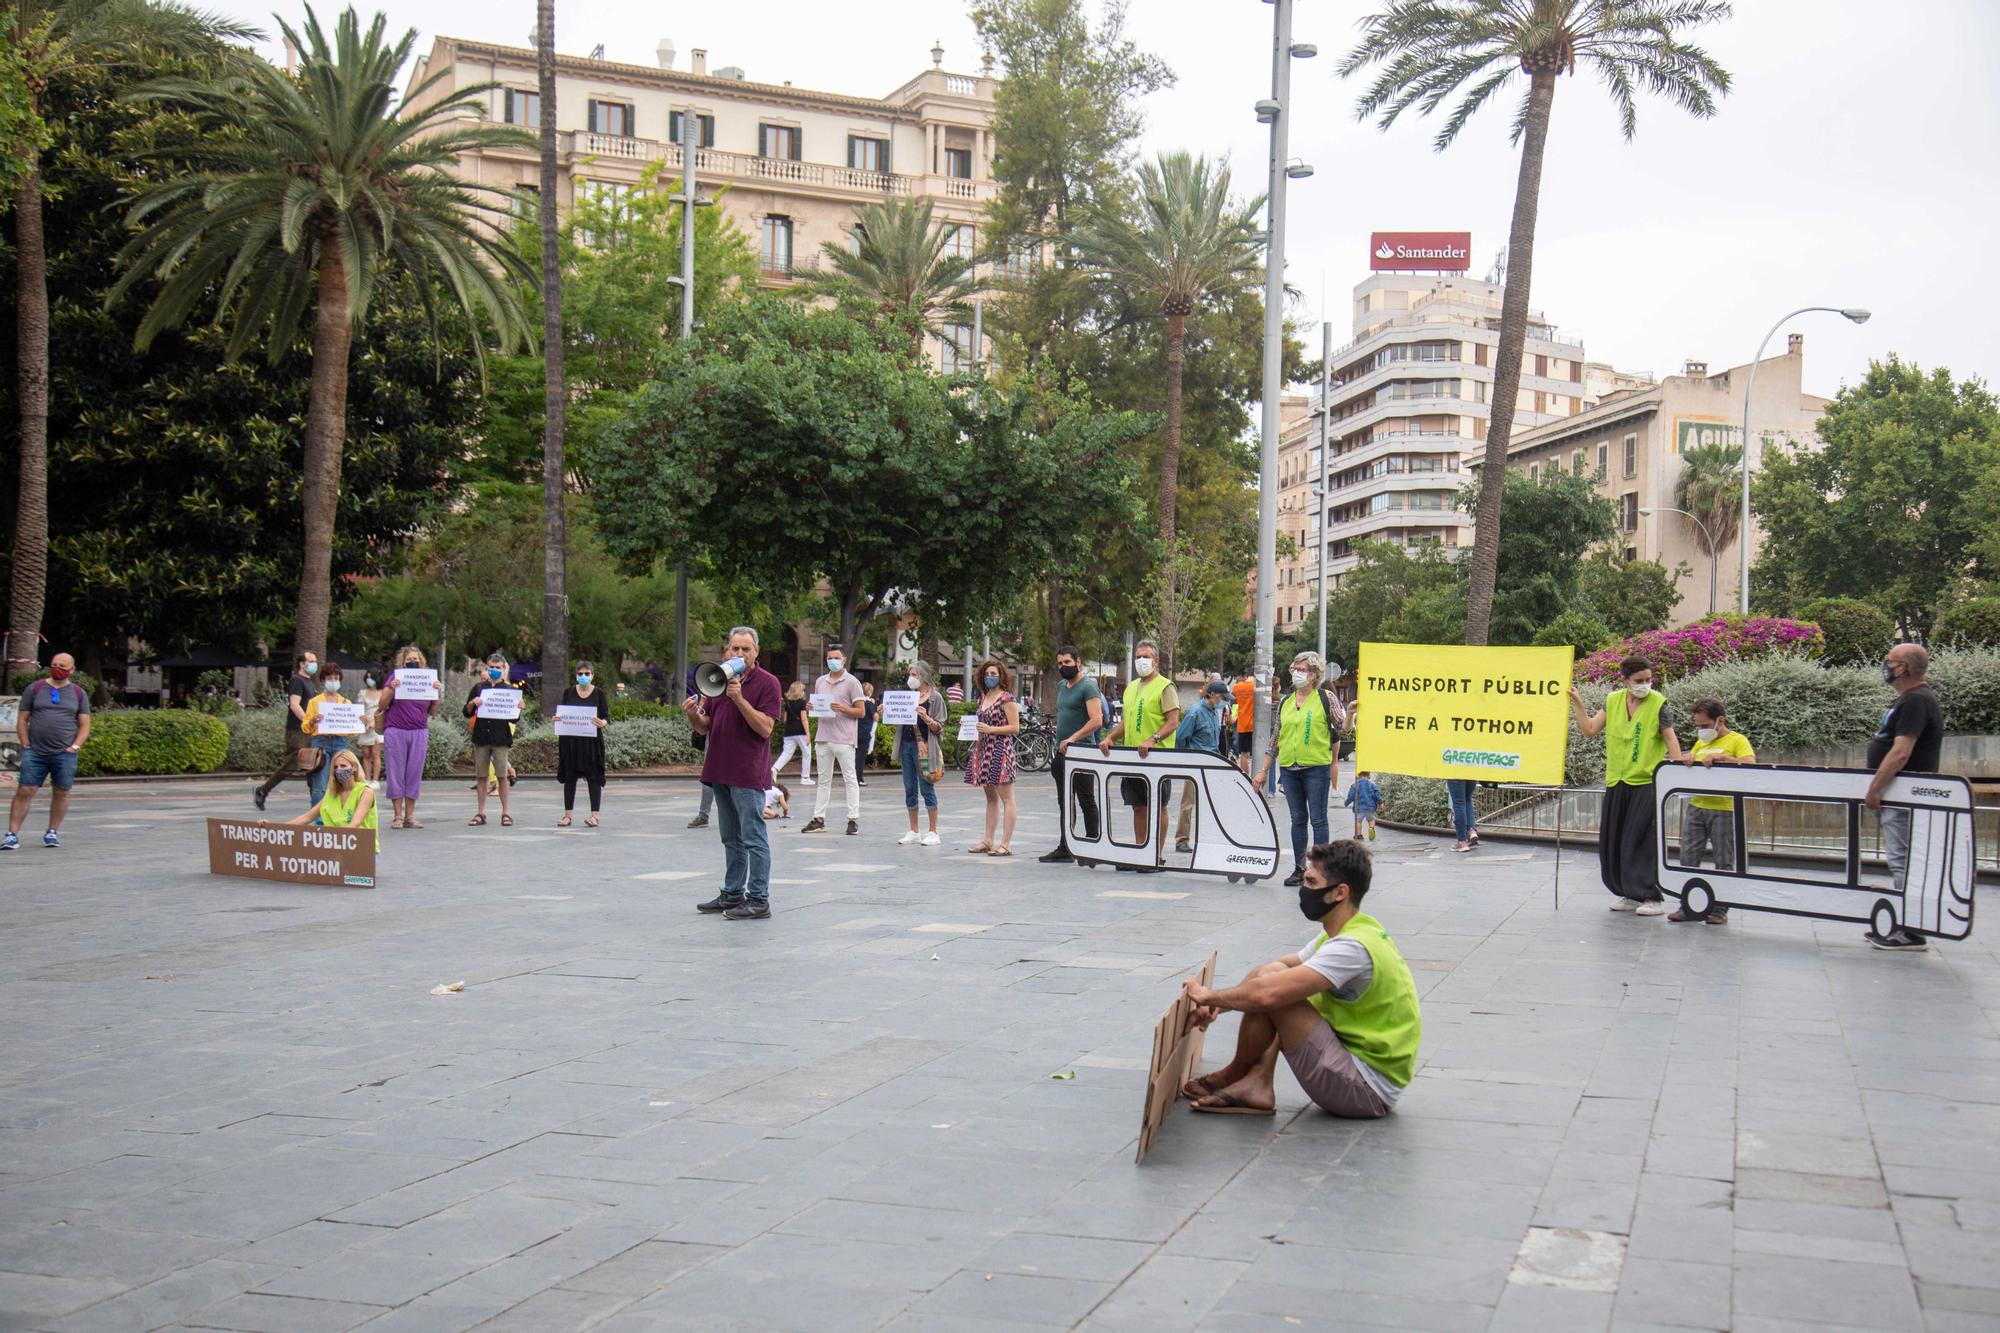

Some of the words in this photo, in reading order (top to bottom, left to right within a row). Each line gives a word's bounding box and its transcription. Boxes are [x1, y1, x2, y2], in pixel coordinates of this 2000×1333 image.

[1397, 245, 1466, 258] Santander
[1367, 676, 1472, 693] TRANSPORT
[1483, 675, 1561, 695] PÚBLIC
[1384, 715, 1416, 730] PER
[1428, 716, 1439, 731] A
[1451, 717, 1533, 735] TOTHOM
[1442, 749, 1519, 767] GREENPEACE
[1911, 786, 1952, 798] GREENPEACE
[220, 824, 295, 846] TRANSPORT
[303, 828, 357, 850] PÚBLIC
[235, 851, 259, 869] PER
[265, 855, 274, 871] A
[280, 857, 340, 876] TOTHOM
[1226, 854, 1272, 866] GREENPEACE
